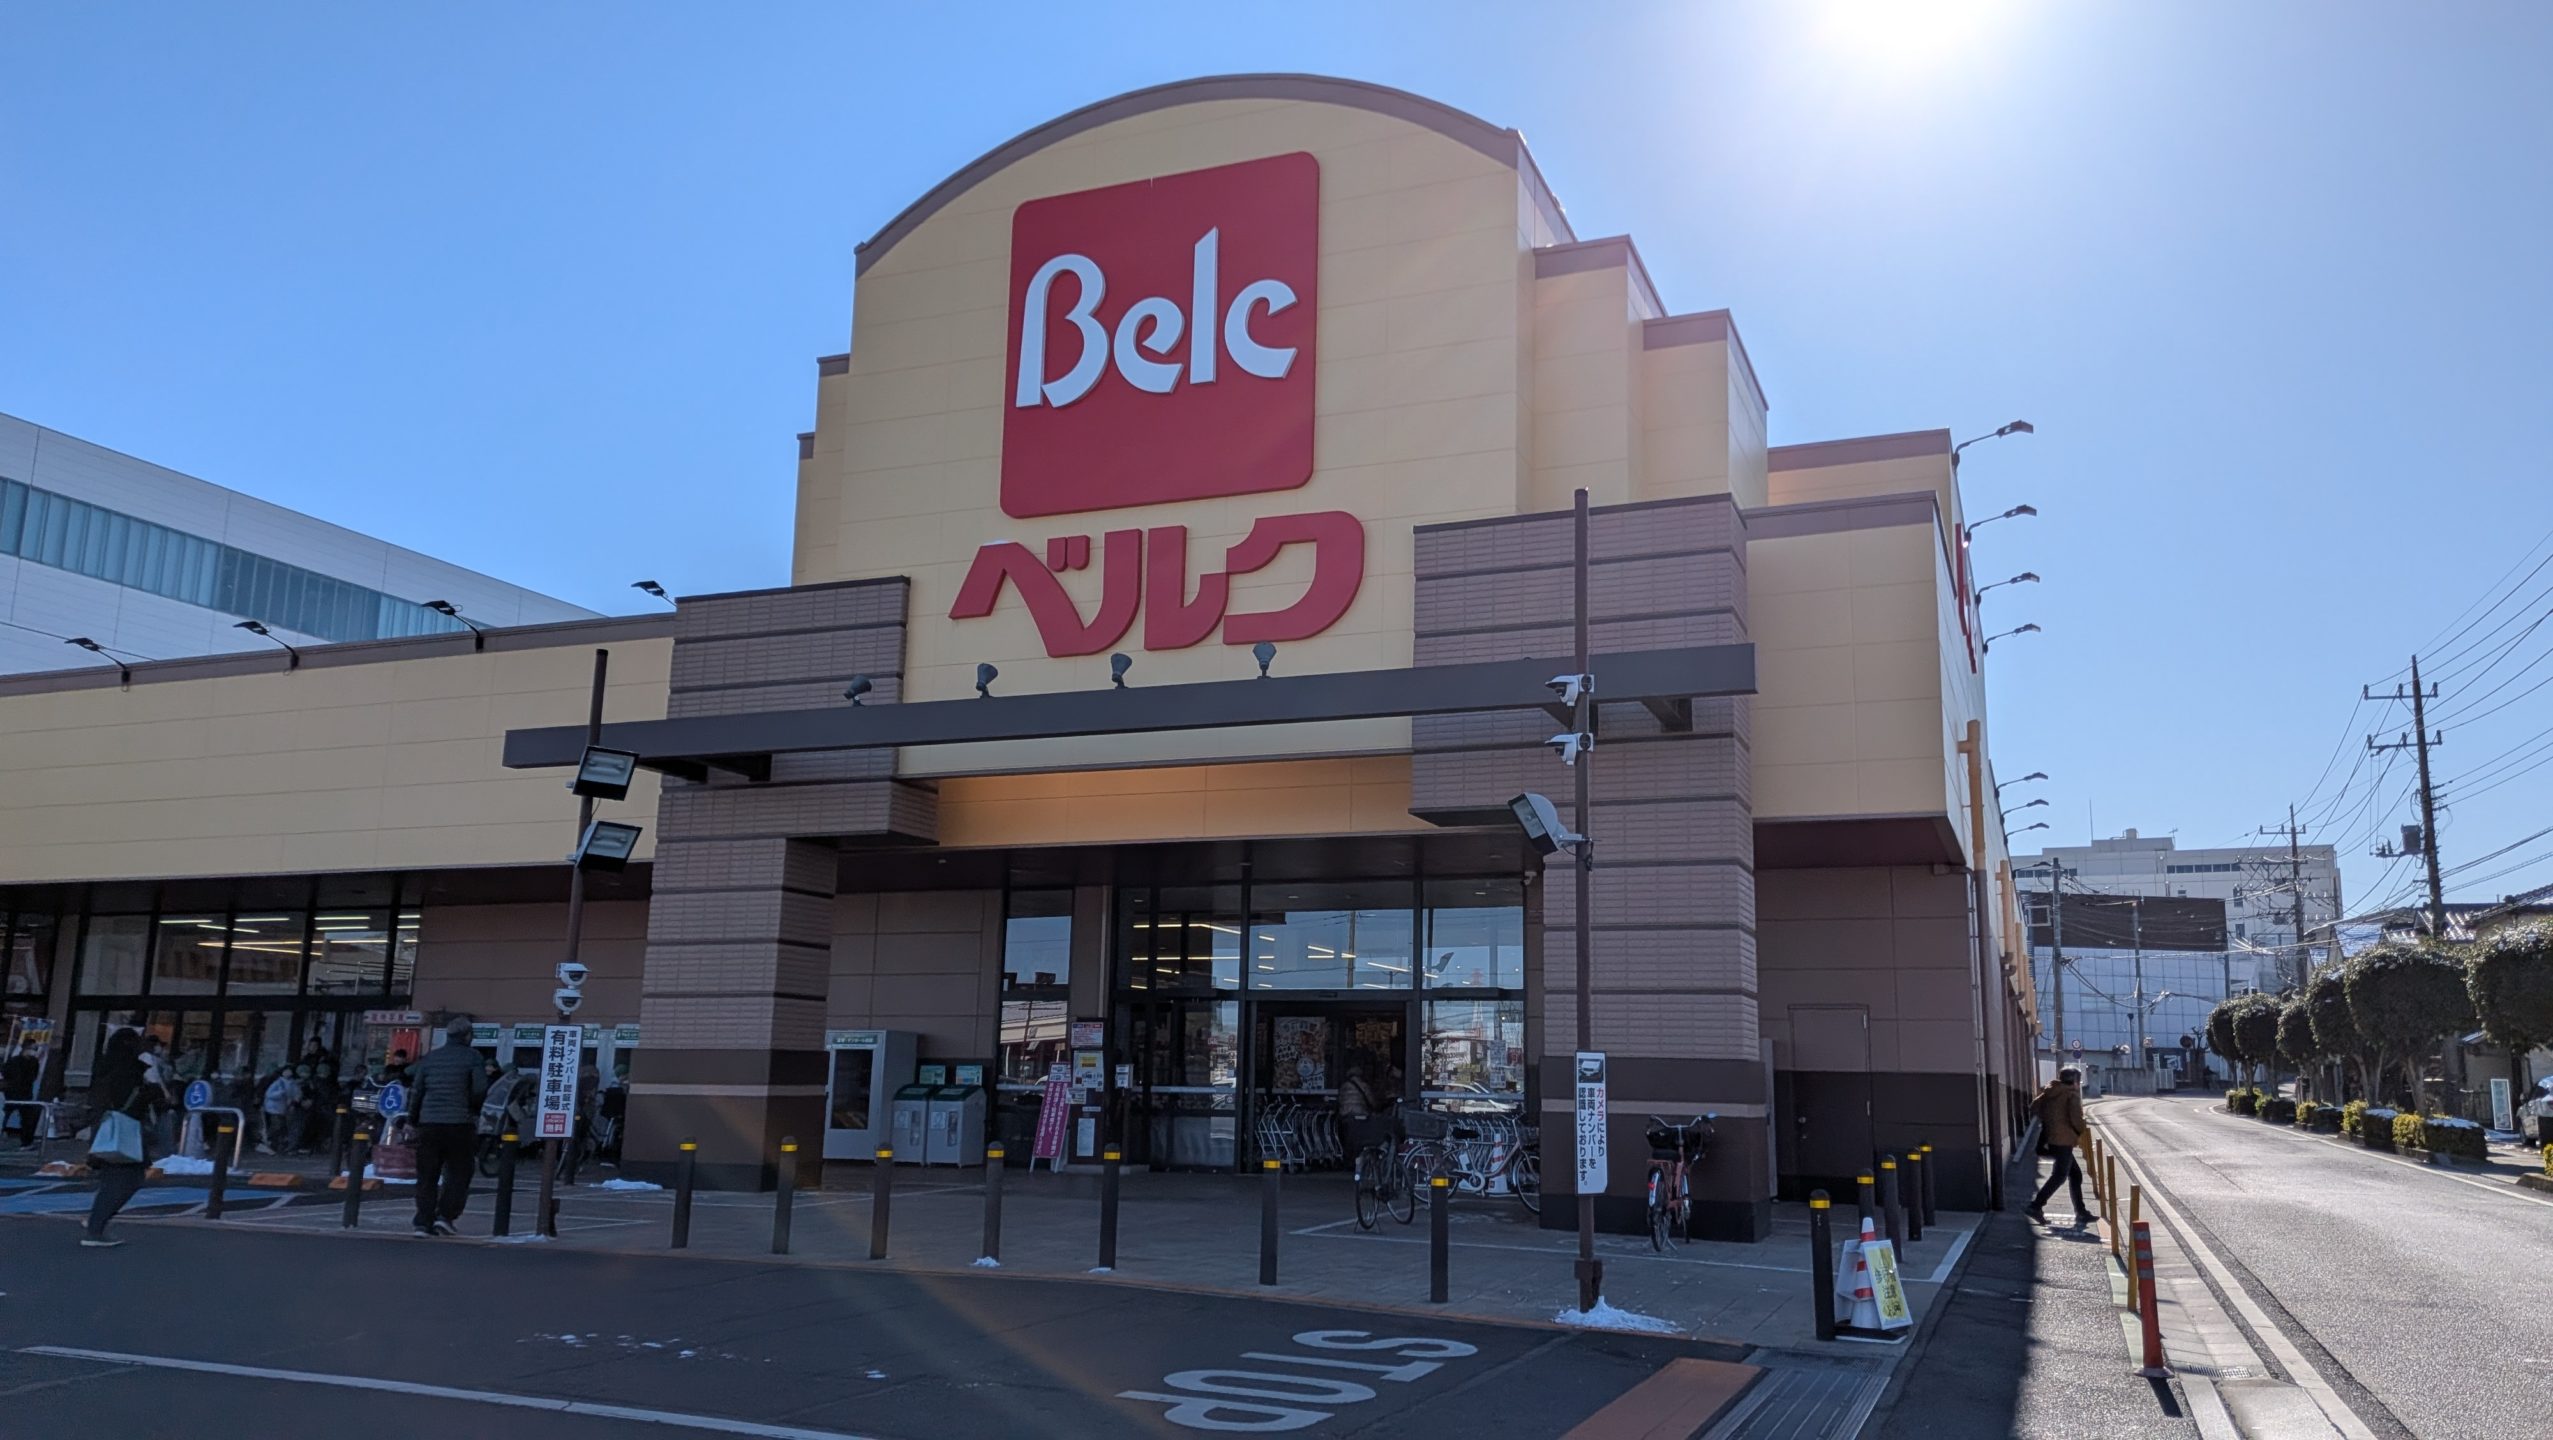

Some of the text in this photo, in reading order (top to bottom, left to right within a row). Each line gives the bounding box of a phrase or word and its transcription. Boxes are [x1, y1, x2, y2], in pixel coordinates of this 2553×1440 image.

[1015, 225, 1298, 408] Belc
[948, 510, 1365, 658] ベルク
[543, 1030, 568, 1111] 有料駐車場
[1578, 1087, 1588, 1187] 認識しております。
[1587, 1087, 1597, 1170] 車両ナンバーを
[1597, 1088, 1605, 1157] カメラにより
[1115, 1330, 1479, 1432] STOP
